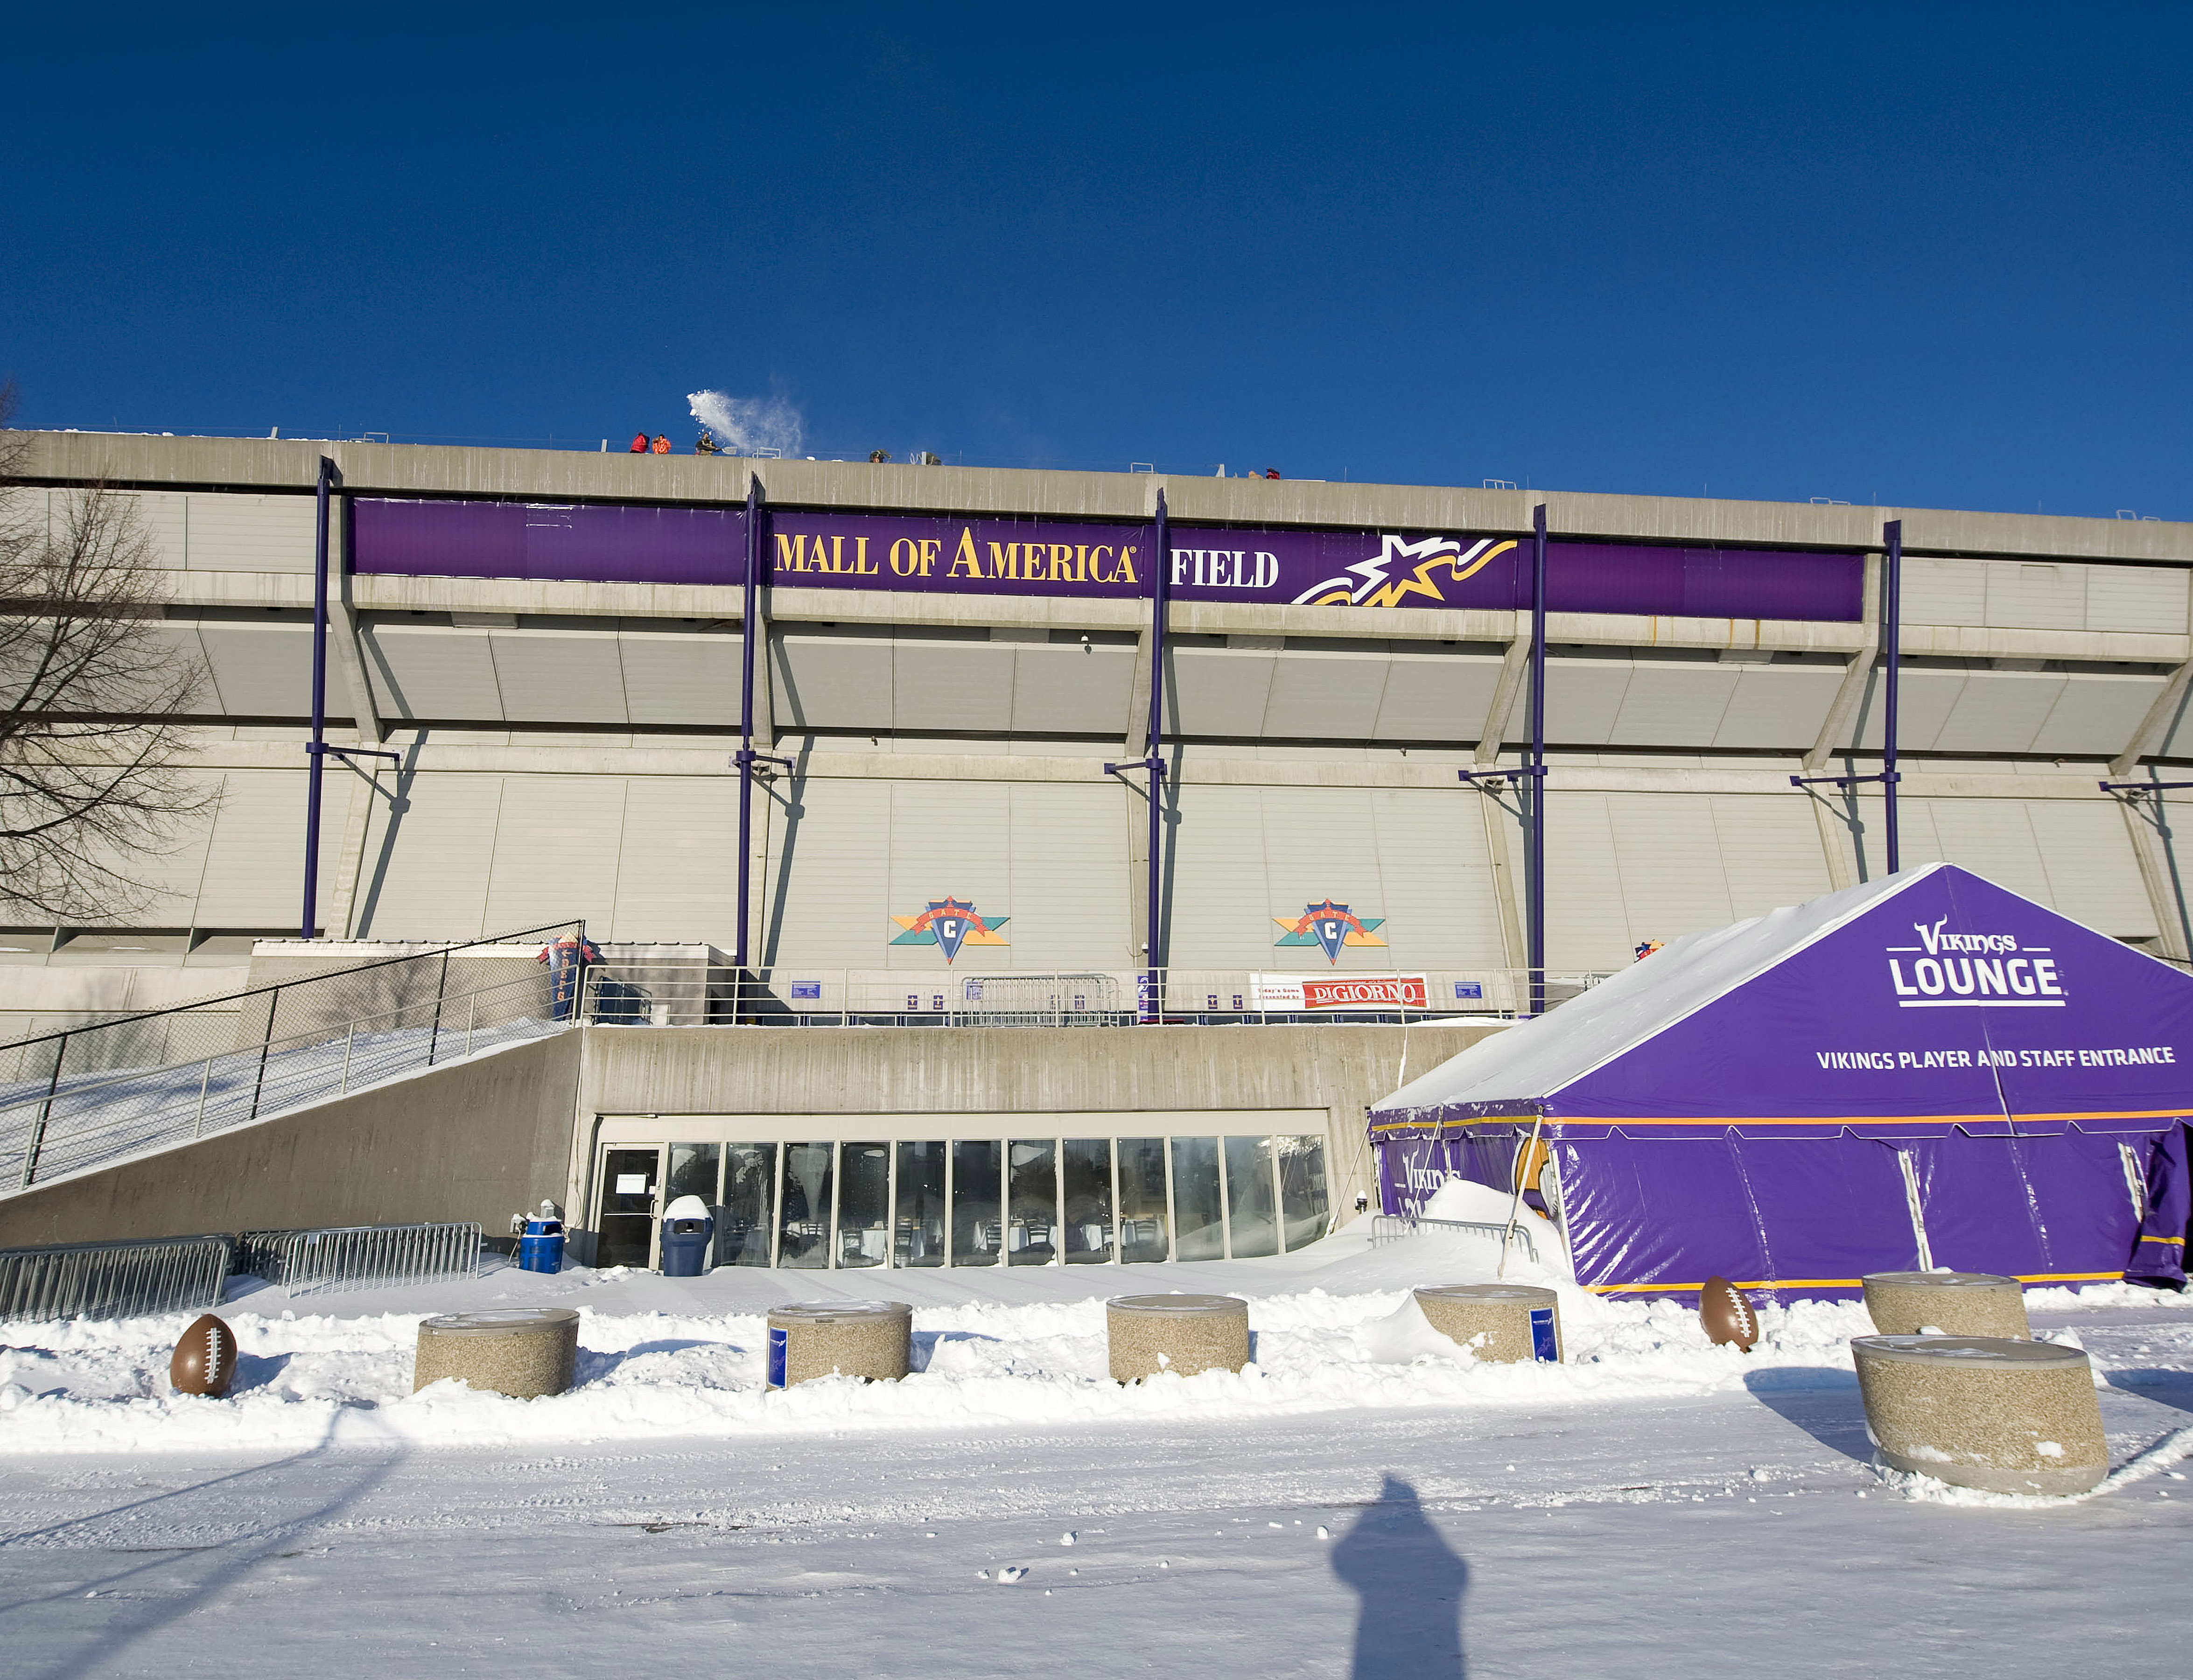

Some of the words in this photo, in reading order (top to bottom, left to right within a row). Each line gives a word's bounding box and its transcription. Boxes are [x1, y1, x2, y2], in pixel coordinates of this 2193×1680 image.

[774, 534, 878, 574] MALL
[890, 538, 941, 576] OF
[1170, 549, 1279, 588] FIELD
[944, 920, 956, 938] C
[1324, 922, 1337, 939] C
[1889, 958, 2062, 995] LOUNGE
[1816, 1051, 1895, 1070] VIKINGS
[1898, 1050, 1973, 1069] PLAYER
[1977, 1050, 2018, 1067] AND
[2019, 1050, 2076, 1067] STAFF
[2078, 1047, 2176, 1067] ENTRANCE
